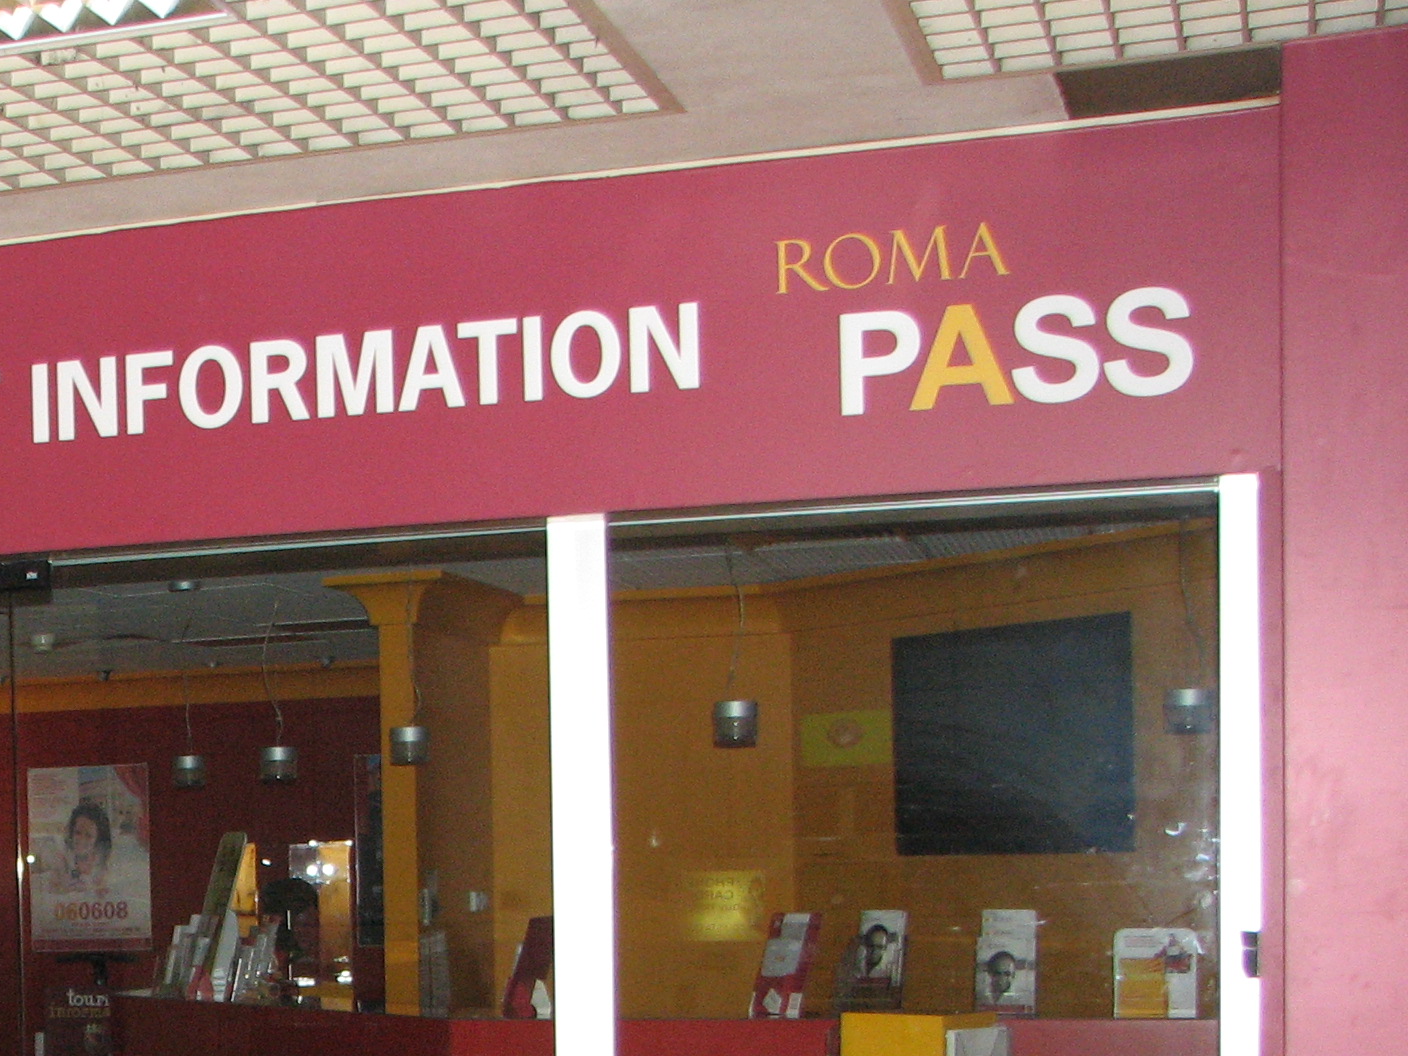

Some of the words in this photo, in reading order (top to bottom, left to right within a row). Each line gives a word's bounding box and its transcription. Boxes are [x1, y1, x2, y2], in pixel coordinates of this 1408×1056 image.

[775, 222, 1010, 294] ROMA
[31, 301, 700, 443] INFORMATION
[839, 286, 1194, 416] PASS
[66, 988, 110, 1007] touri
